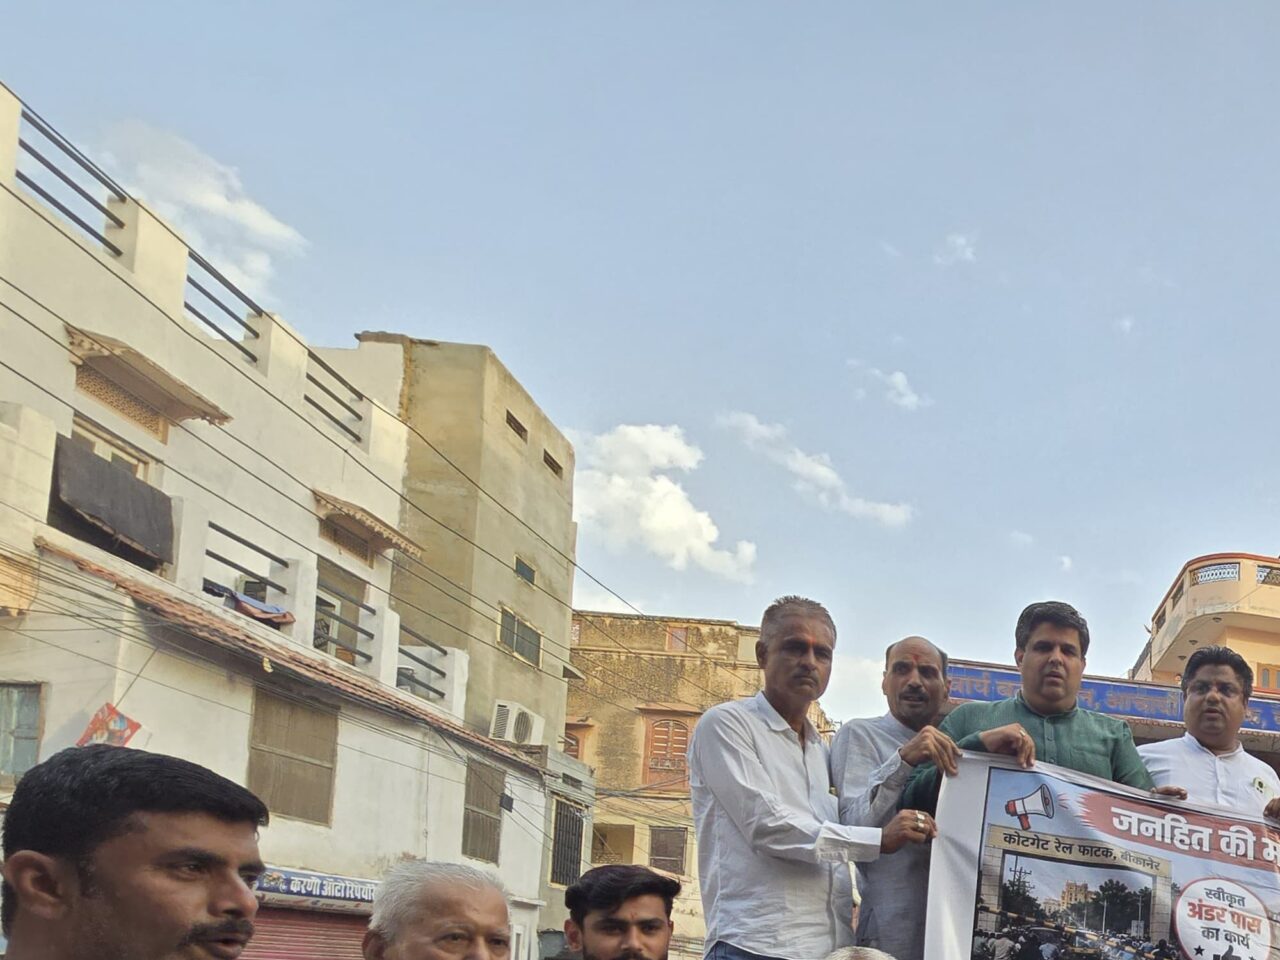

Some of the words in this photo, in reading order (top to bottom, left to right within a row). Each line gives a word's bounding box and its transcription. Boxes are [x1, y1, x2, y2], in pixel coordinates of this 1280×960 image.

[1110, 806, 1213, 853] जनहित
[1218, 825, 1257, 861] की
[1002, 831, 1051, 851] कोटगेट
[1054, 839, 1074, 855] रेल
[1077, 846, 1118, 862] फाटक,
[1120, 850, 1161, 872] बीकानेर
[1204, 886, 1246, 908] स्वीकृत
[1187, 899, 1227, 923] अंडर
[1229, 909, 1263, 934] पास
[1201, 926, 1220, 942] का
[1225, 930, 1251, 950] कार्य
